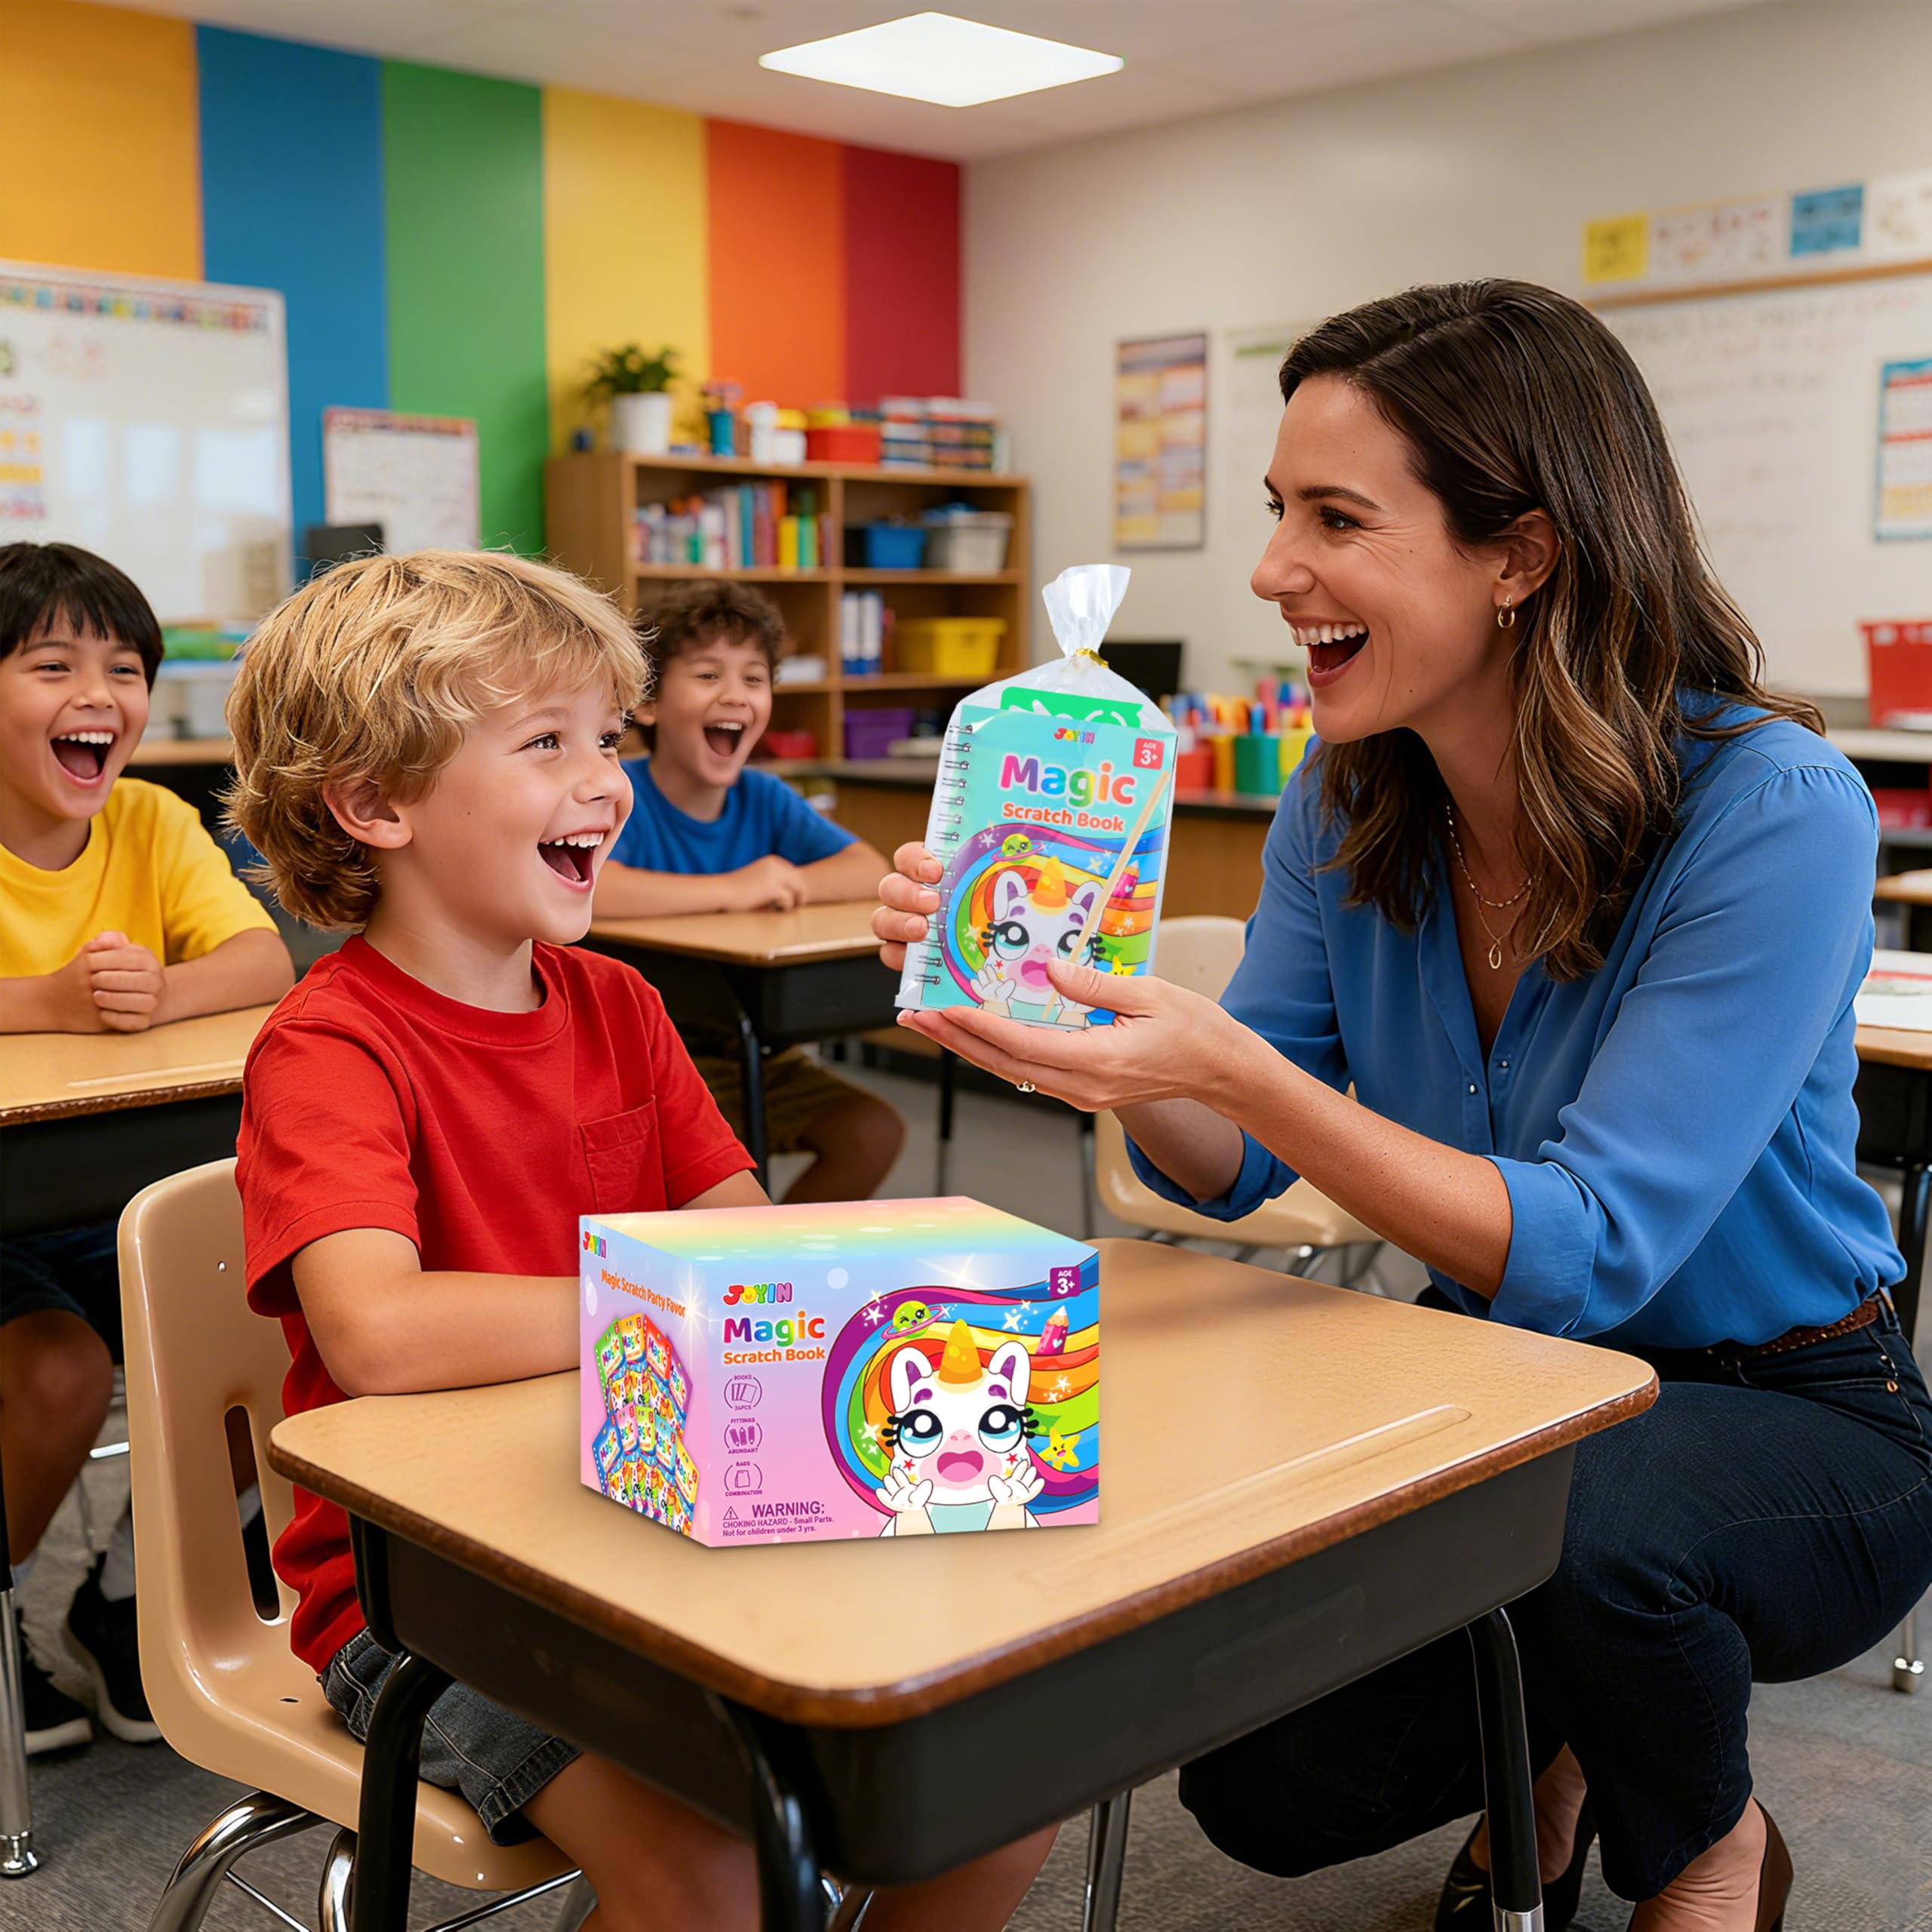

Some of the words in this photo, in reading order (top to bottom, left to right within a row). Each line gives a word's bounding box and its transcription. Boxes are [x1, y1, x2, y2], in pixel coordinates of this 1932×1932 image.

[1054, 727, 1095, 745] JOYIN
[1140, 749, 1158, 766] 3+
[1000, 755, 1135, 808] Magic
[1002, 803, 1072, 826] Scratch
[1077, 812, 1124, 832] Book
[583, 1231, 607, 1259] JOYIN
[601, 1268, 620, 1291] Magic
[621, 1277, 647, 1301] Scratch
[647, 1288, 666, 1312] Party
[666, 1297, 685, 1318] Favor
[723, 1282, 792, 1306] JOYIN
[1057, 1278, 1075, 1294] 3+
[724, 1310, 825, 1347] Magic
[724, 1349, 783, 1364] Scratch
[786, 1346, 826, 1361] Book
[752, 1500, 825, 1518] WARNING:
[722, 1520, 756, 1528] CHOKING
[757, 1518, 788, 1527] HAZARD
